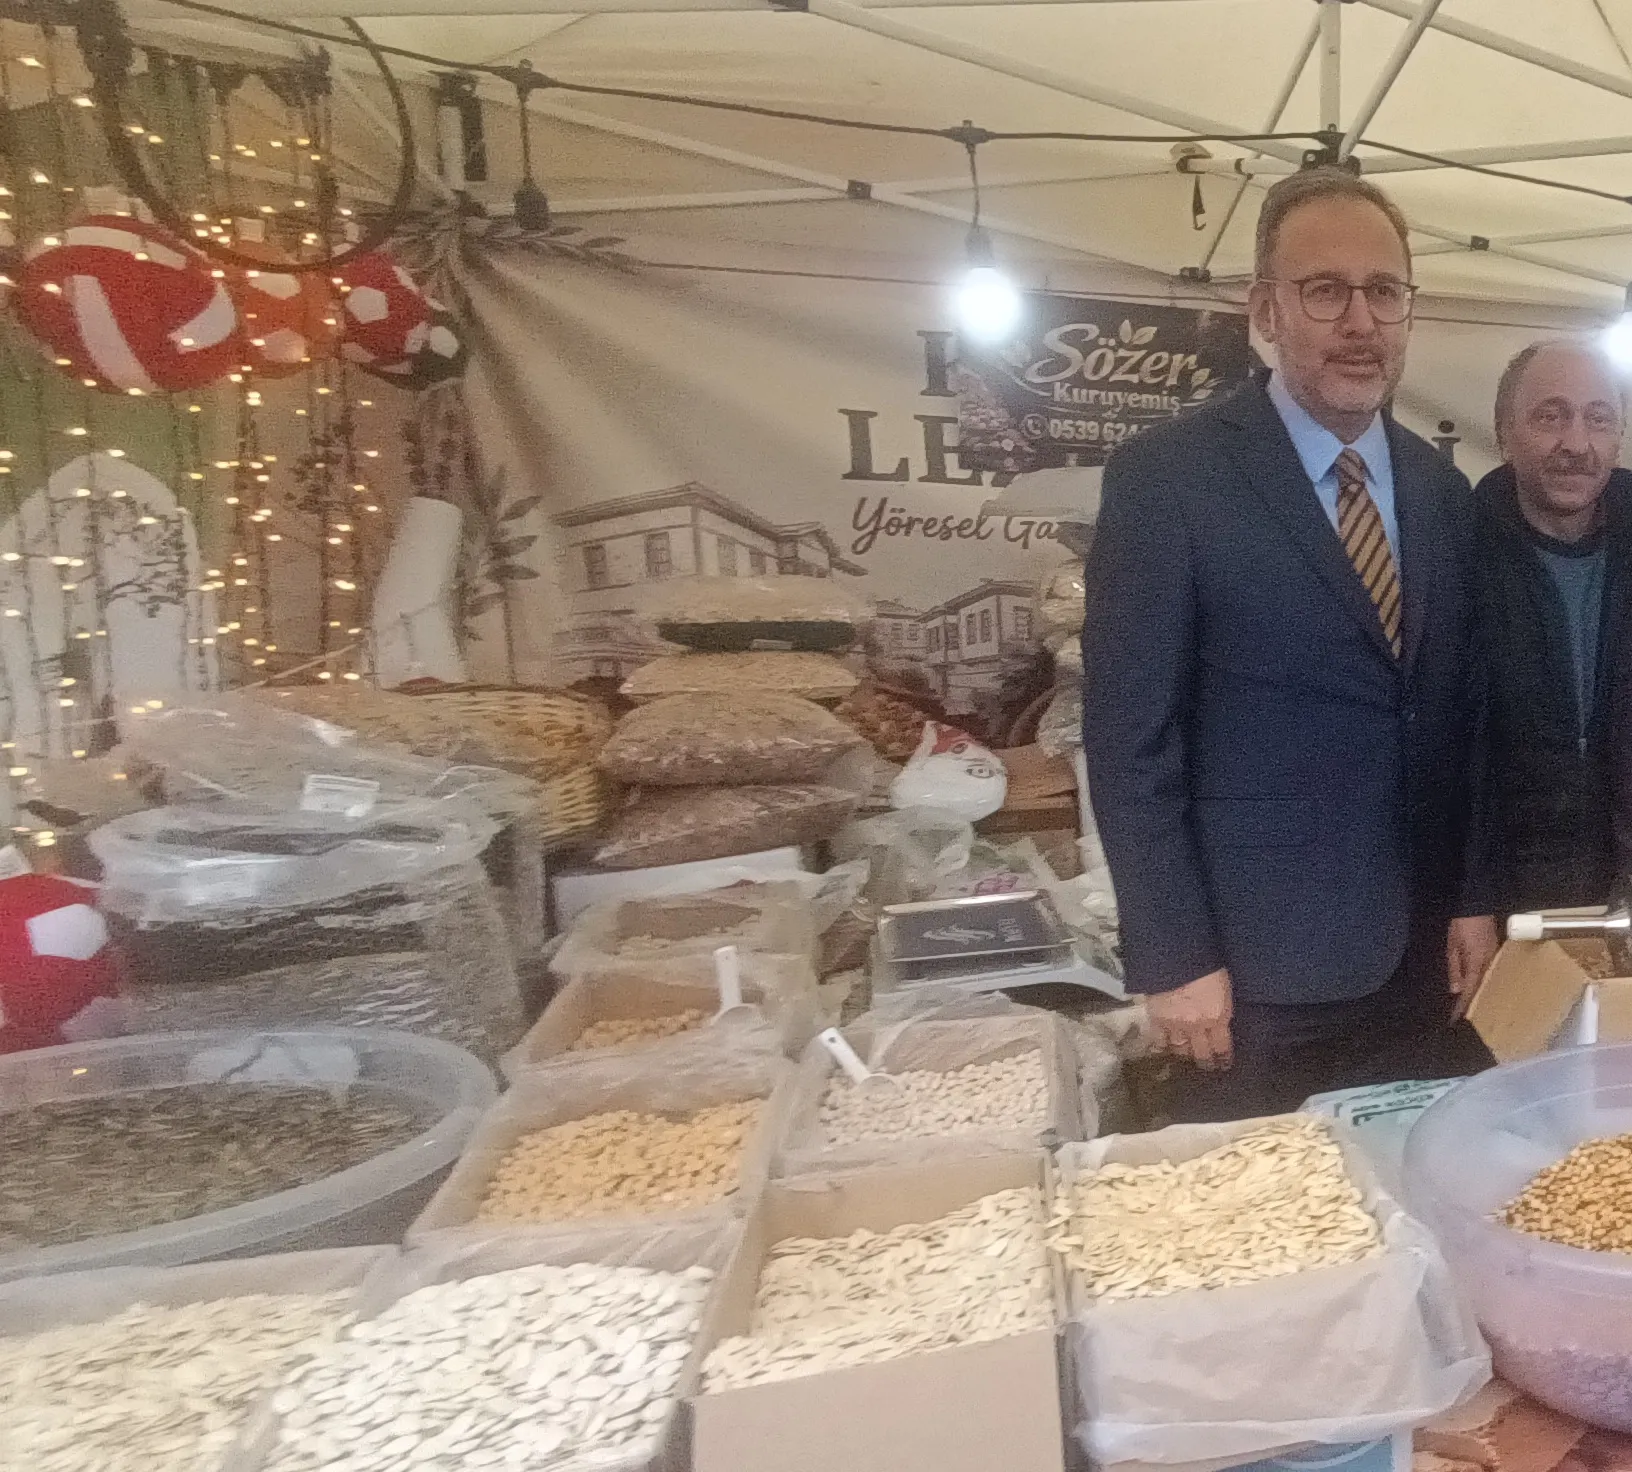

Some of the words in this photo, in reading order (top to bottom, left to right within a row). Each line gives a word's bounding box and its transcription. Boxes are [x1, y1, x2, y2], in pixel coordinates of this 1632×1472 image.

[1025, 323, 1198, 386] Sözer
[1053, 381, 1181, 418] Kuruyemiş
[1050, 418, 1100, 441] 0539
[852, 497, 994, 555] Yöresel
